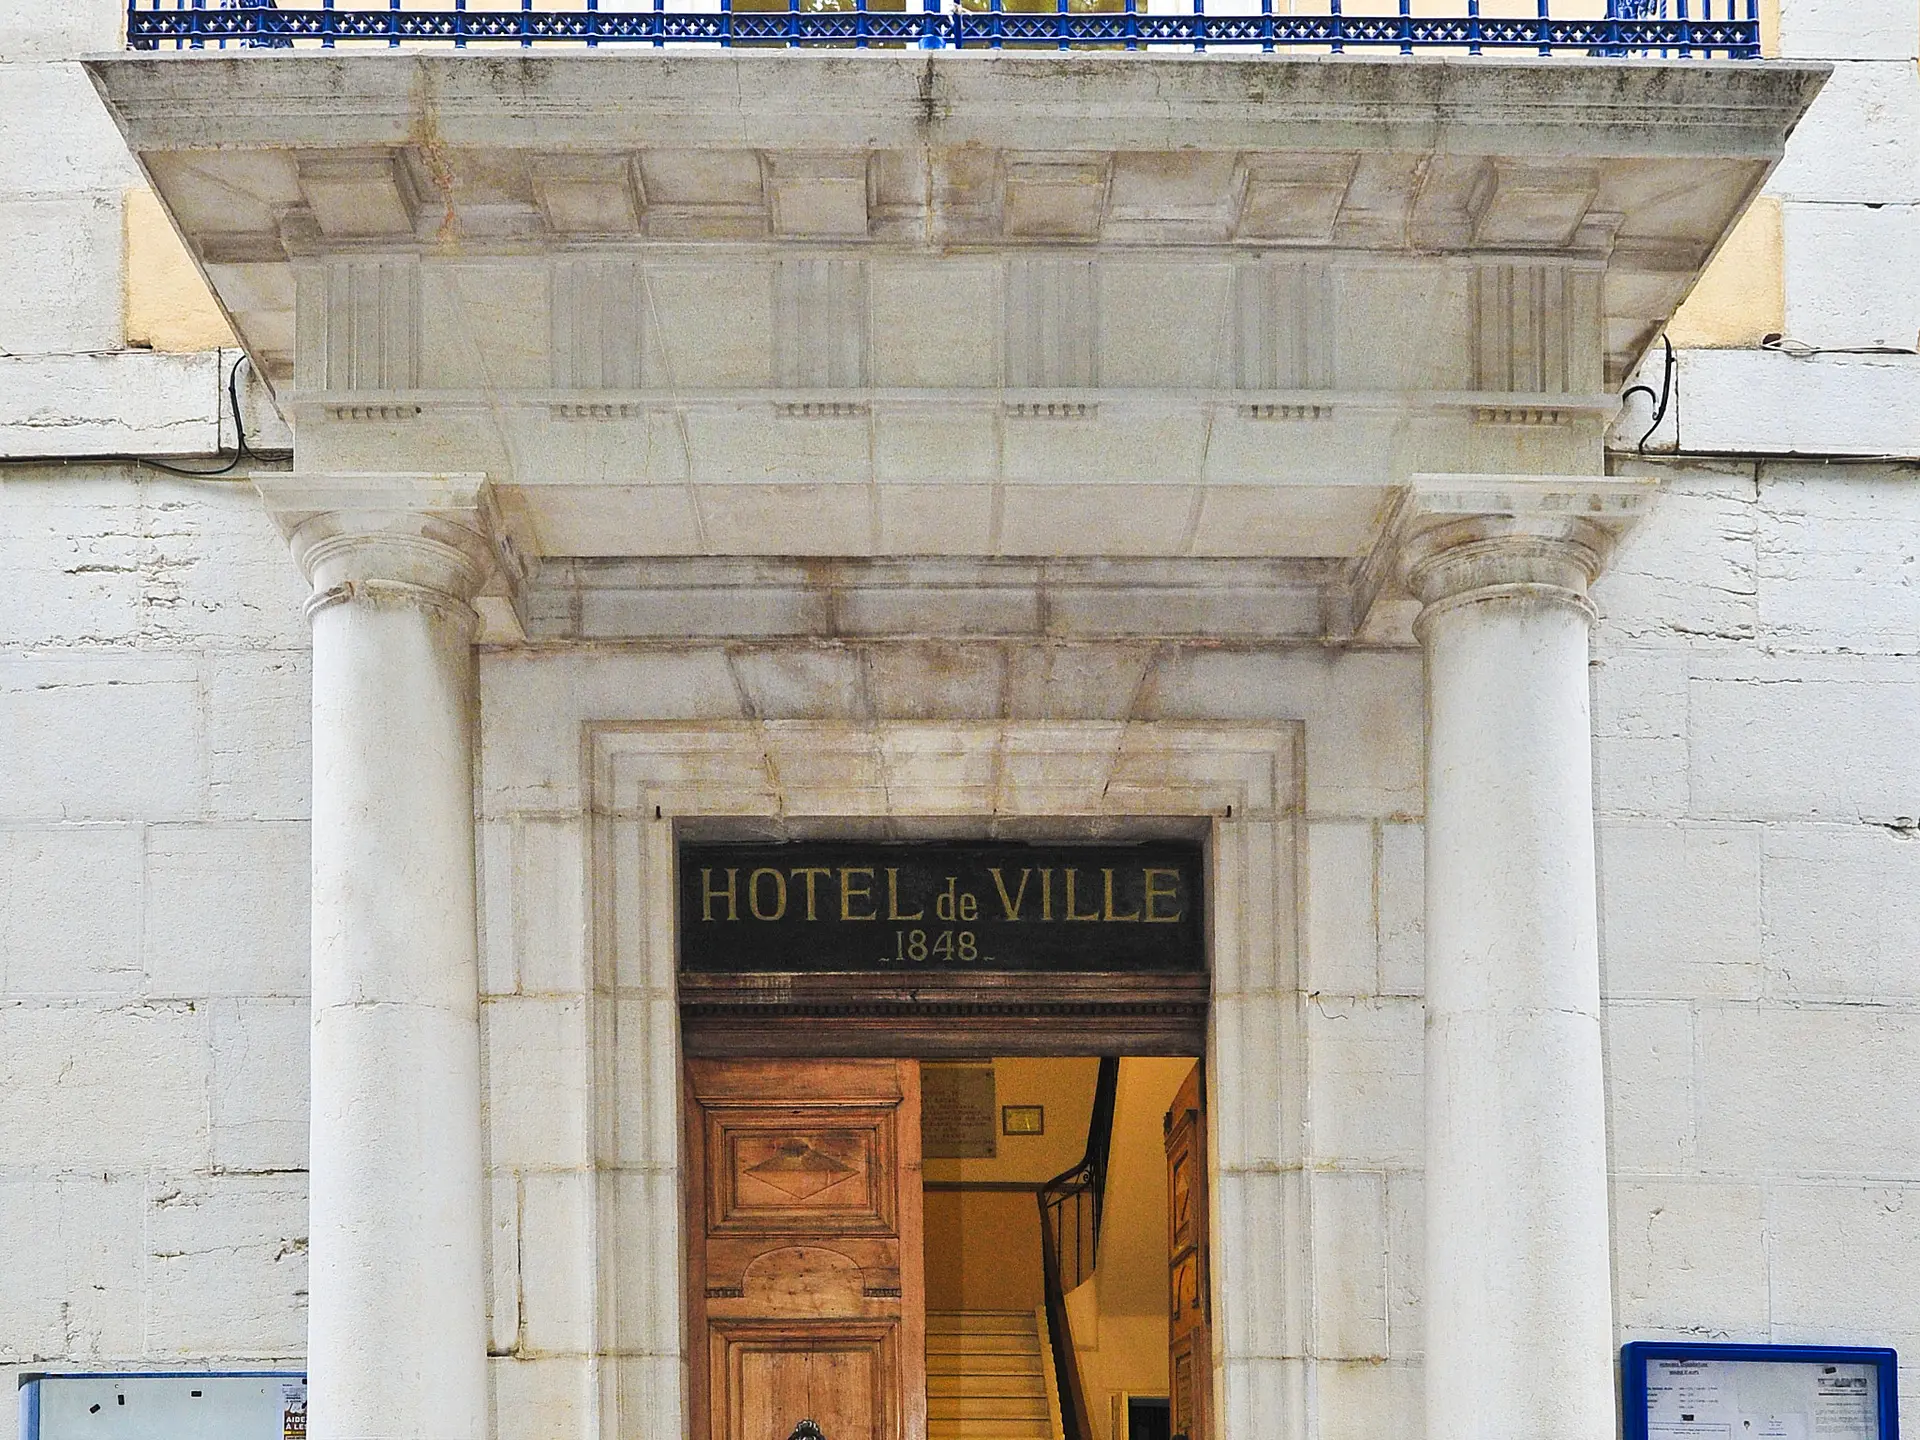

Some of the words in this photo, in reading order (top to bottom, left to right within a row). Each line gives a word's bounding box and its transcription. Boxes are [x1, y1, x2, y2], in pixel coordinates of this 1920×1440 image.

[700, 867, 925, 922] HOTEL
[935, 876, 979, 922] de
[987, 867, 1182, 923] VILLE
